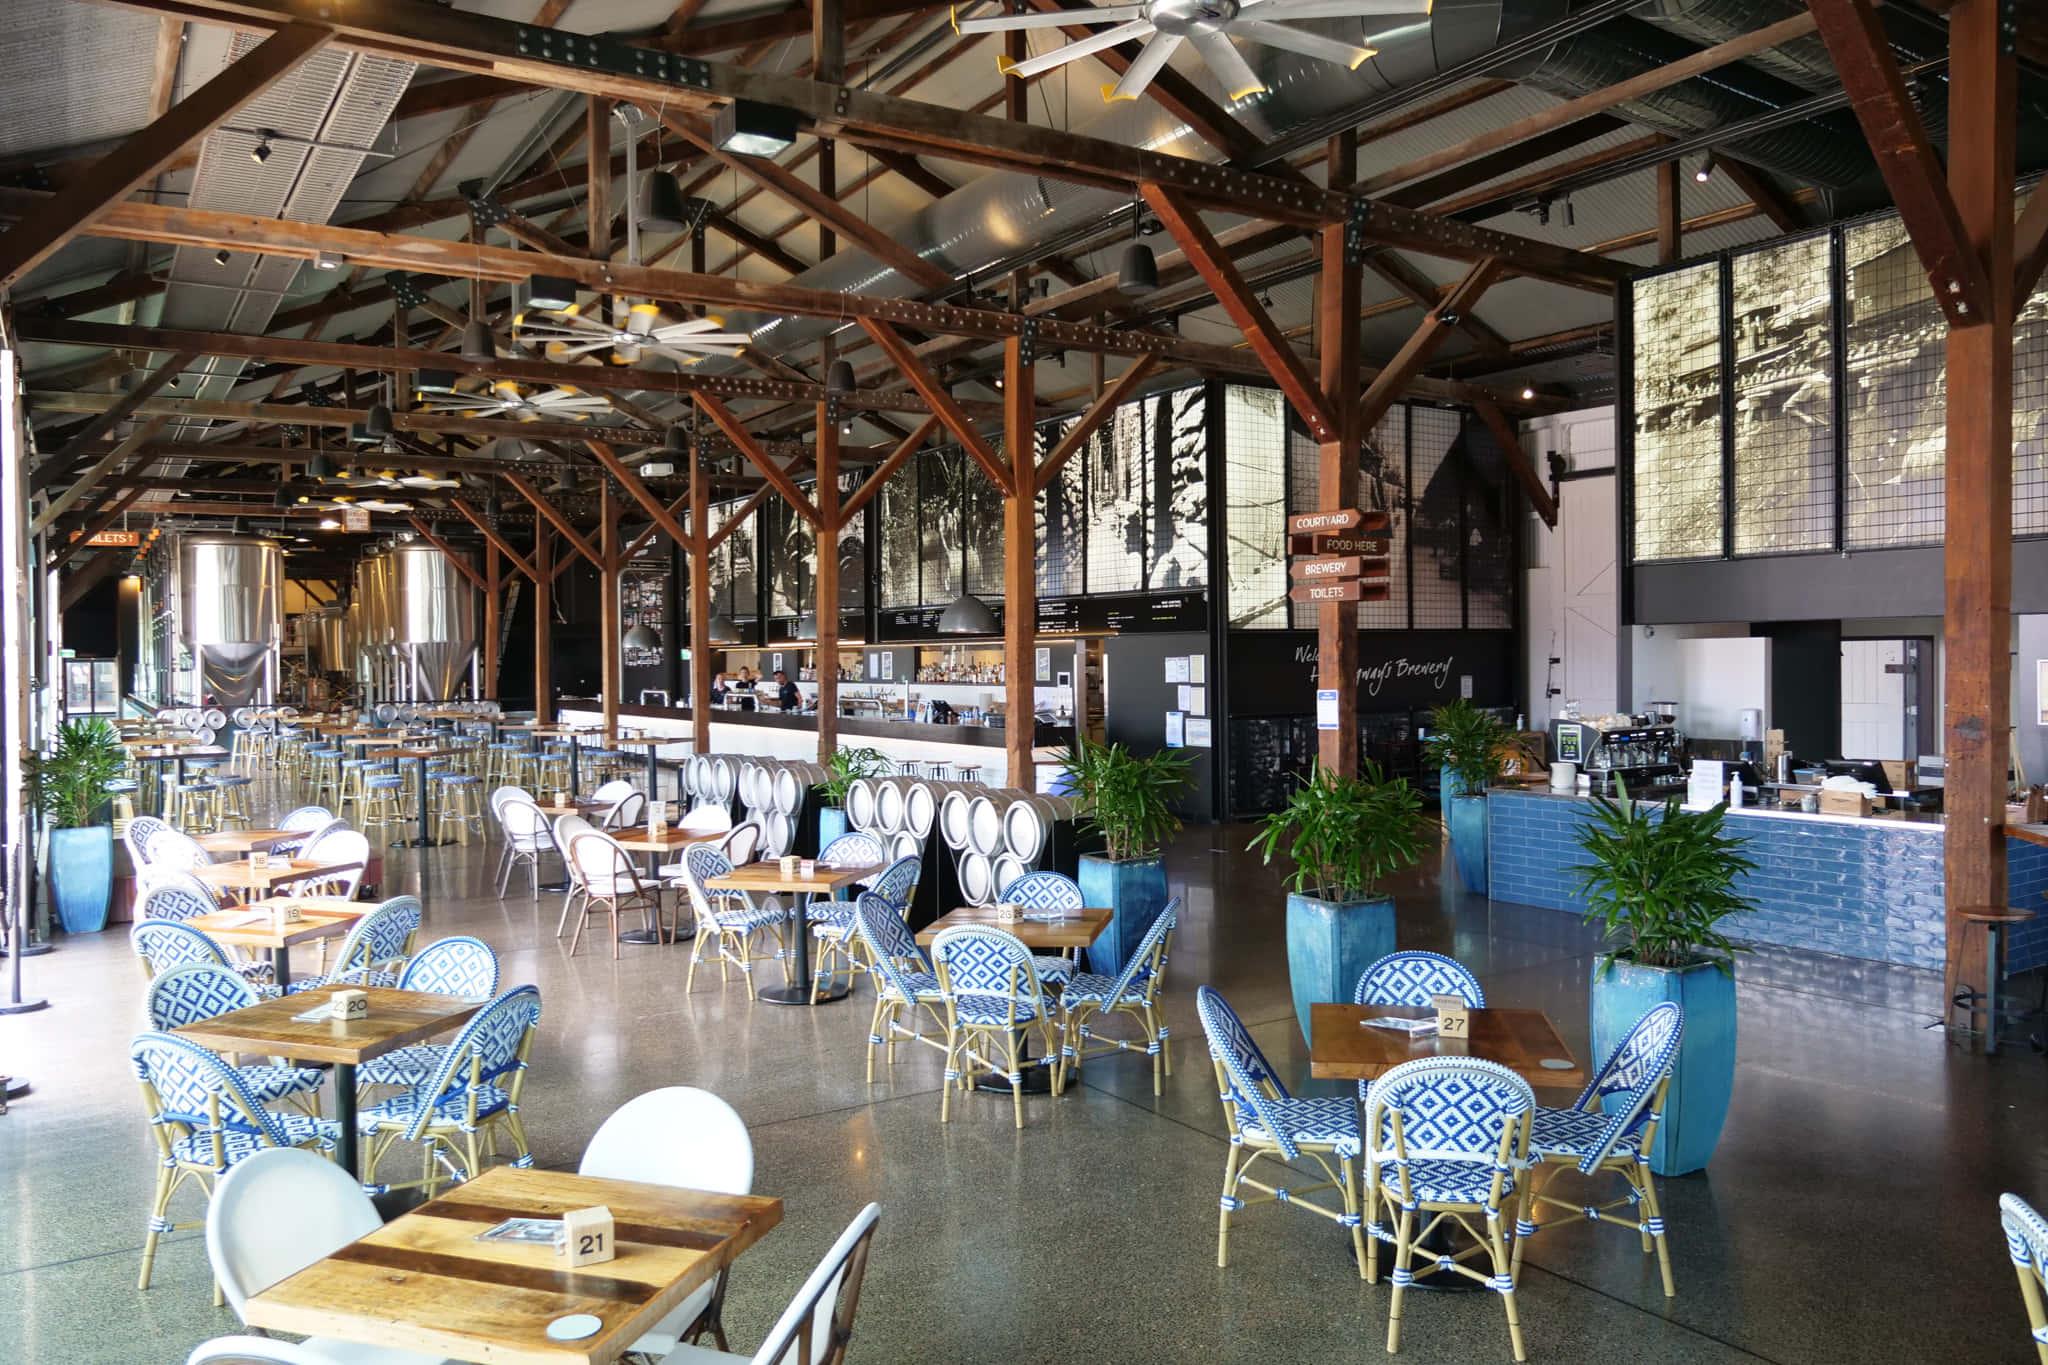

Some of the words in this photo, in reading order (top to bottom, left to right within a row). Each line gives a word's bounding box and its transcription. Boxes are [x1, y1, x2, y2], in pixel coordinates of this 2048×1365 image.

[1297, 513, 1349, 529] COURTYARD
[1327, 539, 1352, 551] FOOD
[1354, 541, 1377, 552] HERE
[1305, 561, 1347, 576] BREWERY
[1310, 586, 1345, 599] TOILETS
[1395, 656, 1454, 689] Brewery
[348, 999, 368, 1013] 20
[1444, 1017, 1465, 1032] 27
[579, 1232, 603, 1256] 21
